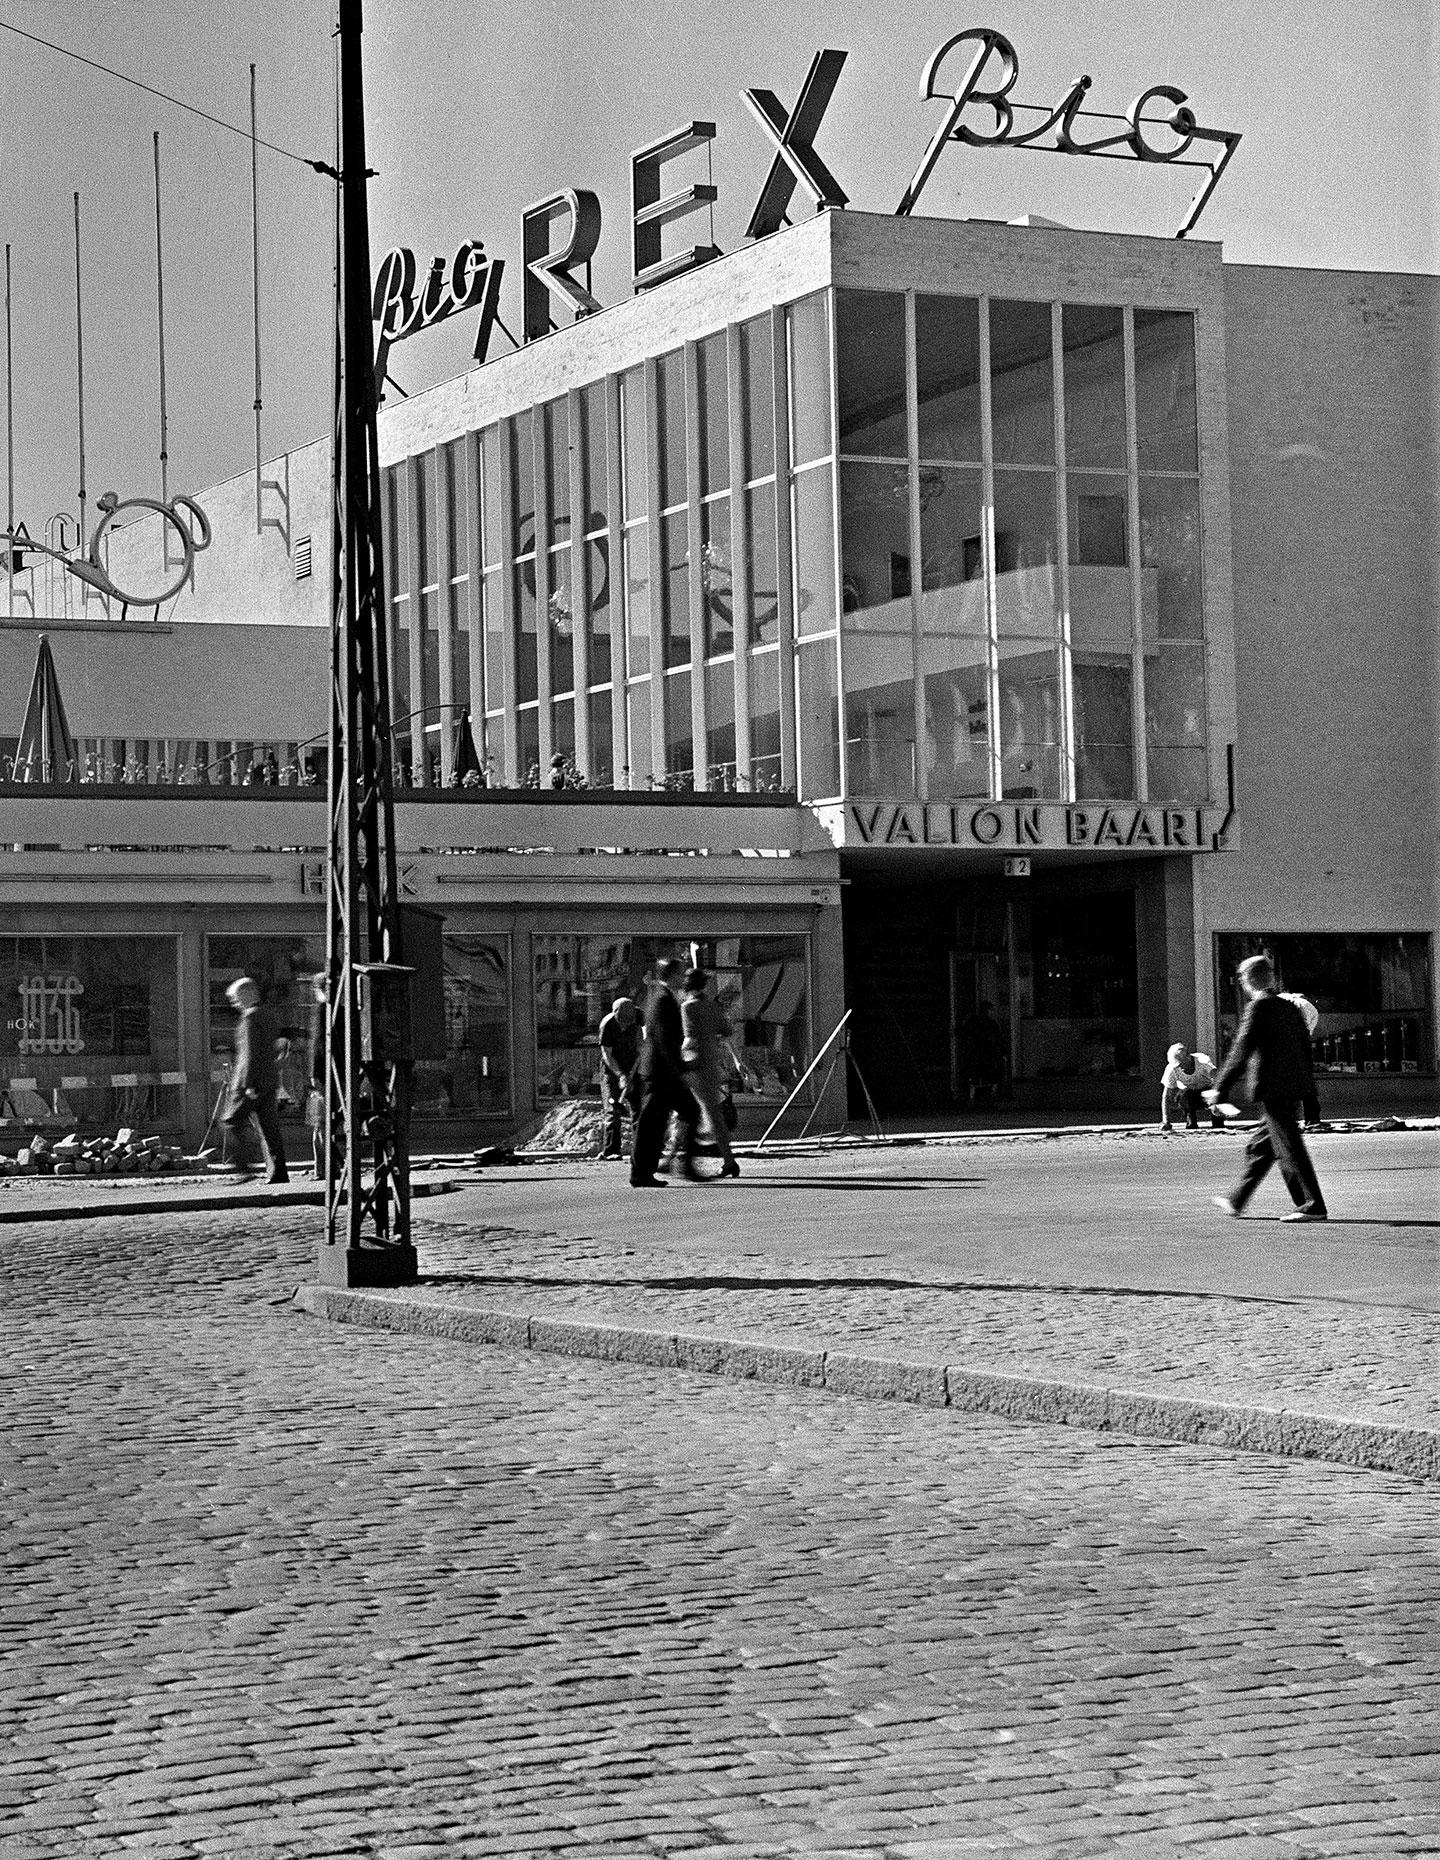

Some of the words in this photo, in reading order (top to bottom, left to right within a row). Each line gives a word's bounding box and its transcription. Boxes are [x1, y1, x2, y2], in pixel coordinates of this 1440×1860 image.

[898, 28, 1242, 238] Bio
[372, 238, 505, 398] Bio
[521, 49, 851, 345] REX
[300, 863, 419, 896] HK
[851, 804, 1042, 845] VALION
[1065, 806, 1205, 846] BAARI
